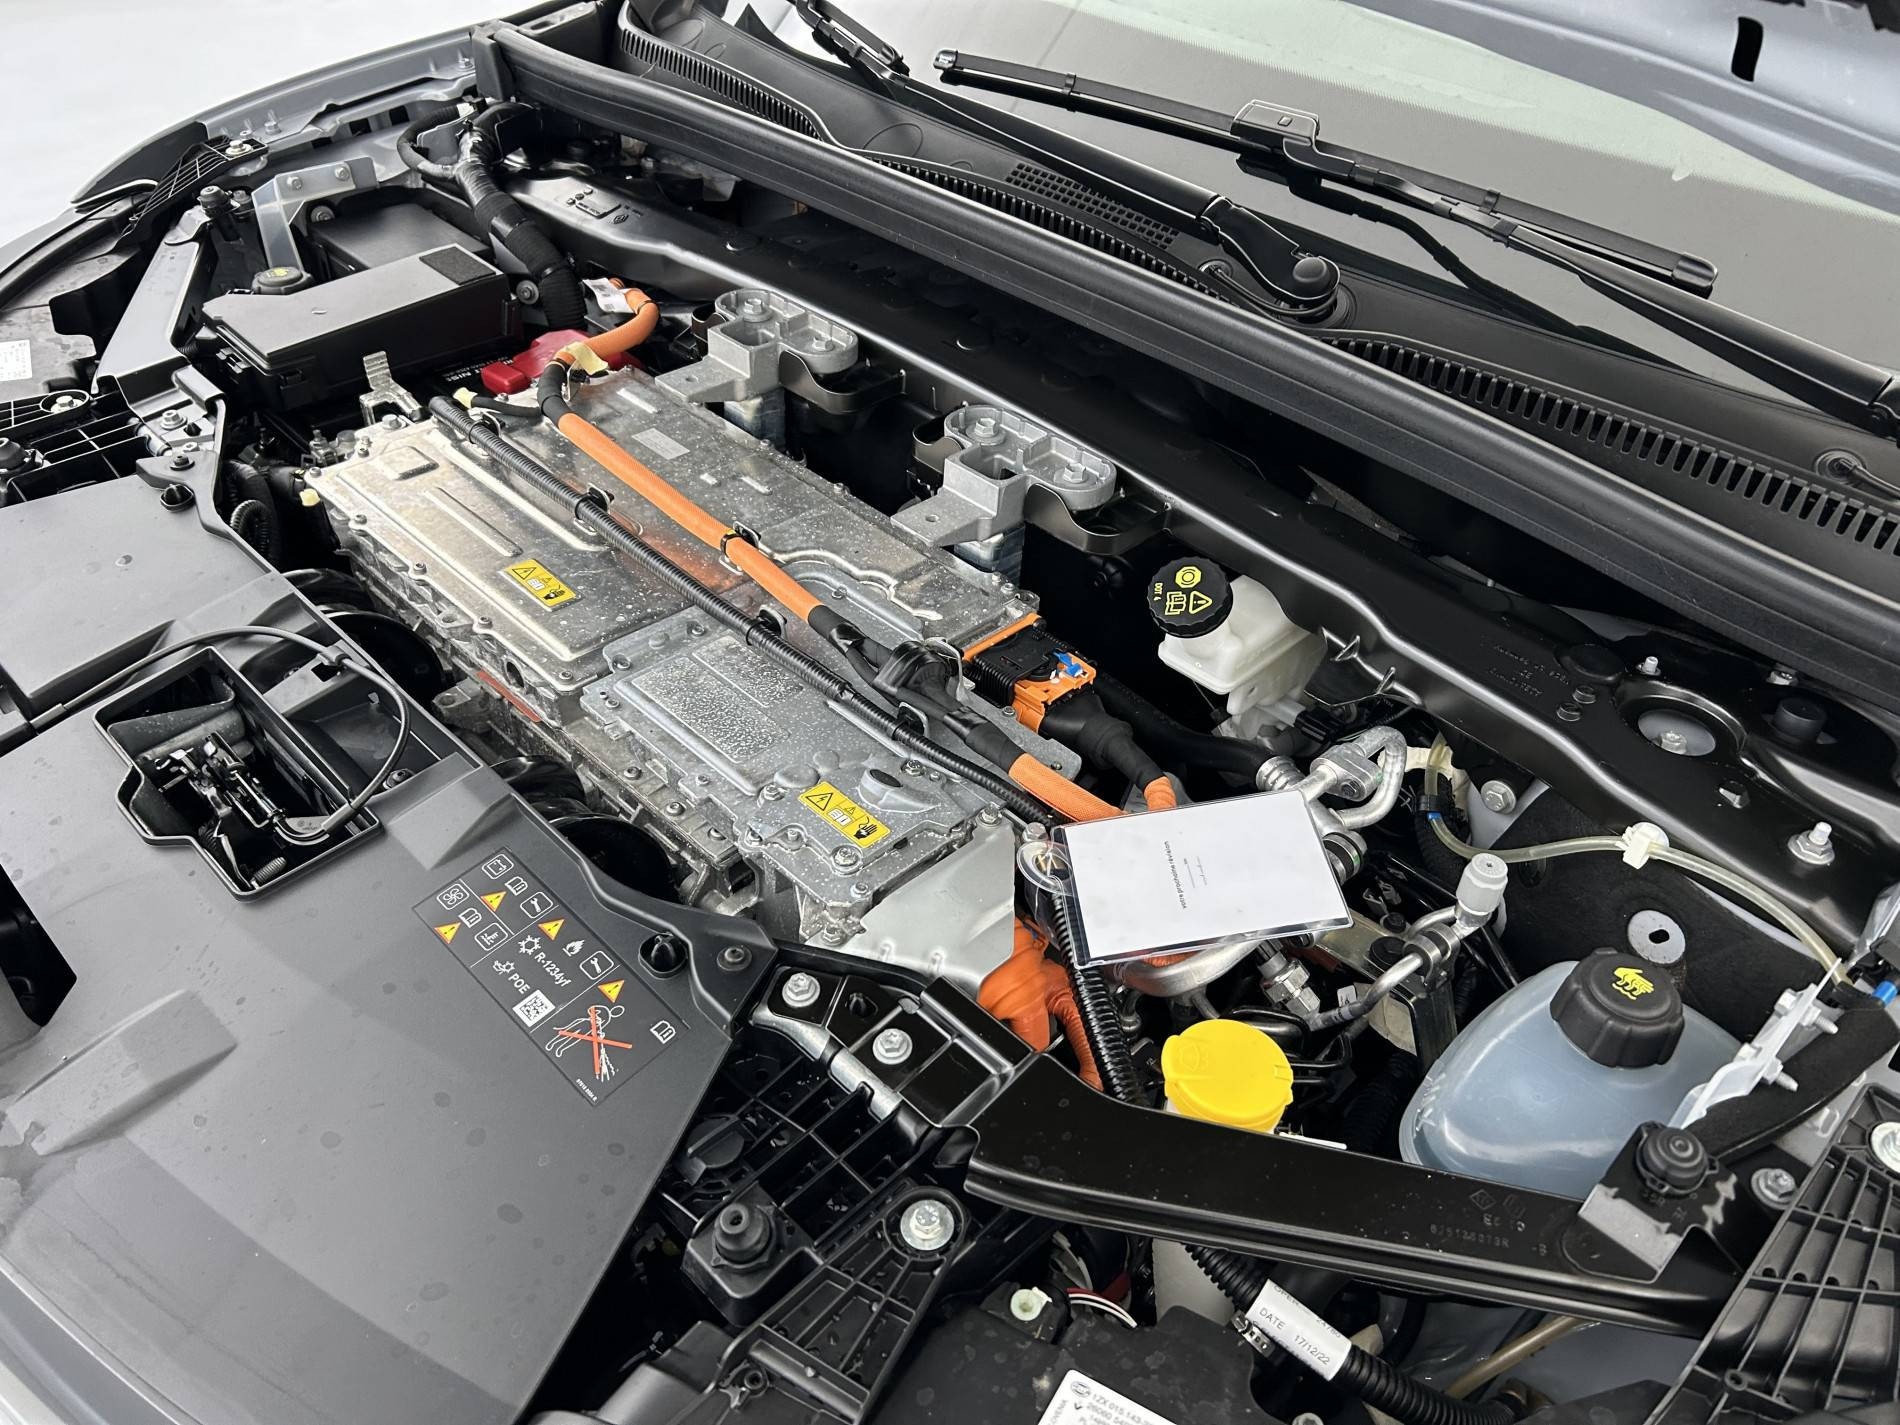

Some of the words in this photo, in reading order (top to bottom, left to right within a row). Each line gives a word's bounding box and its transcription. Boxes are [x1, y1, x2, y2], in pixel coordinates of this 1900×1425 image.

[508, 973, 531, 995] POE
[1259, 1307, 1286, 1330] DATE
[1294, 1335, 1331, 1366] 17/12/22
